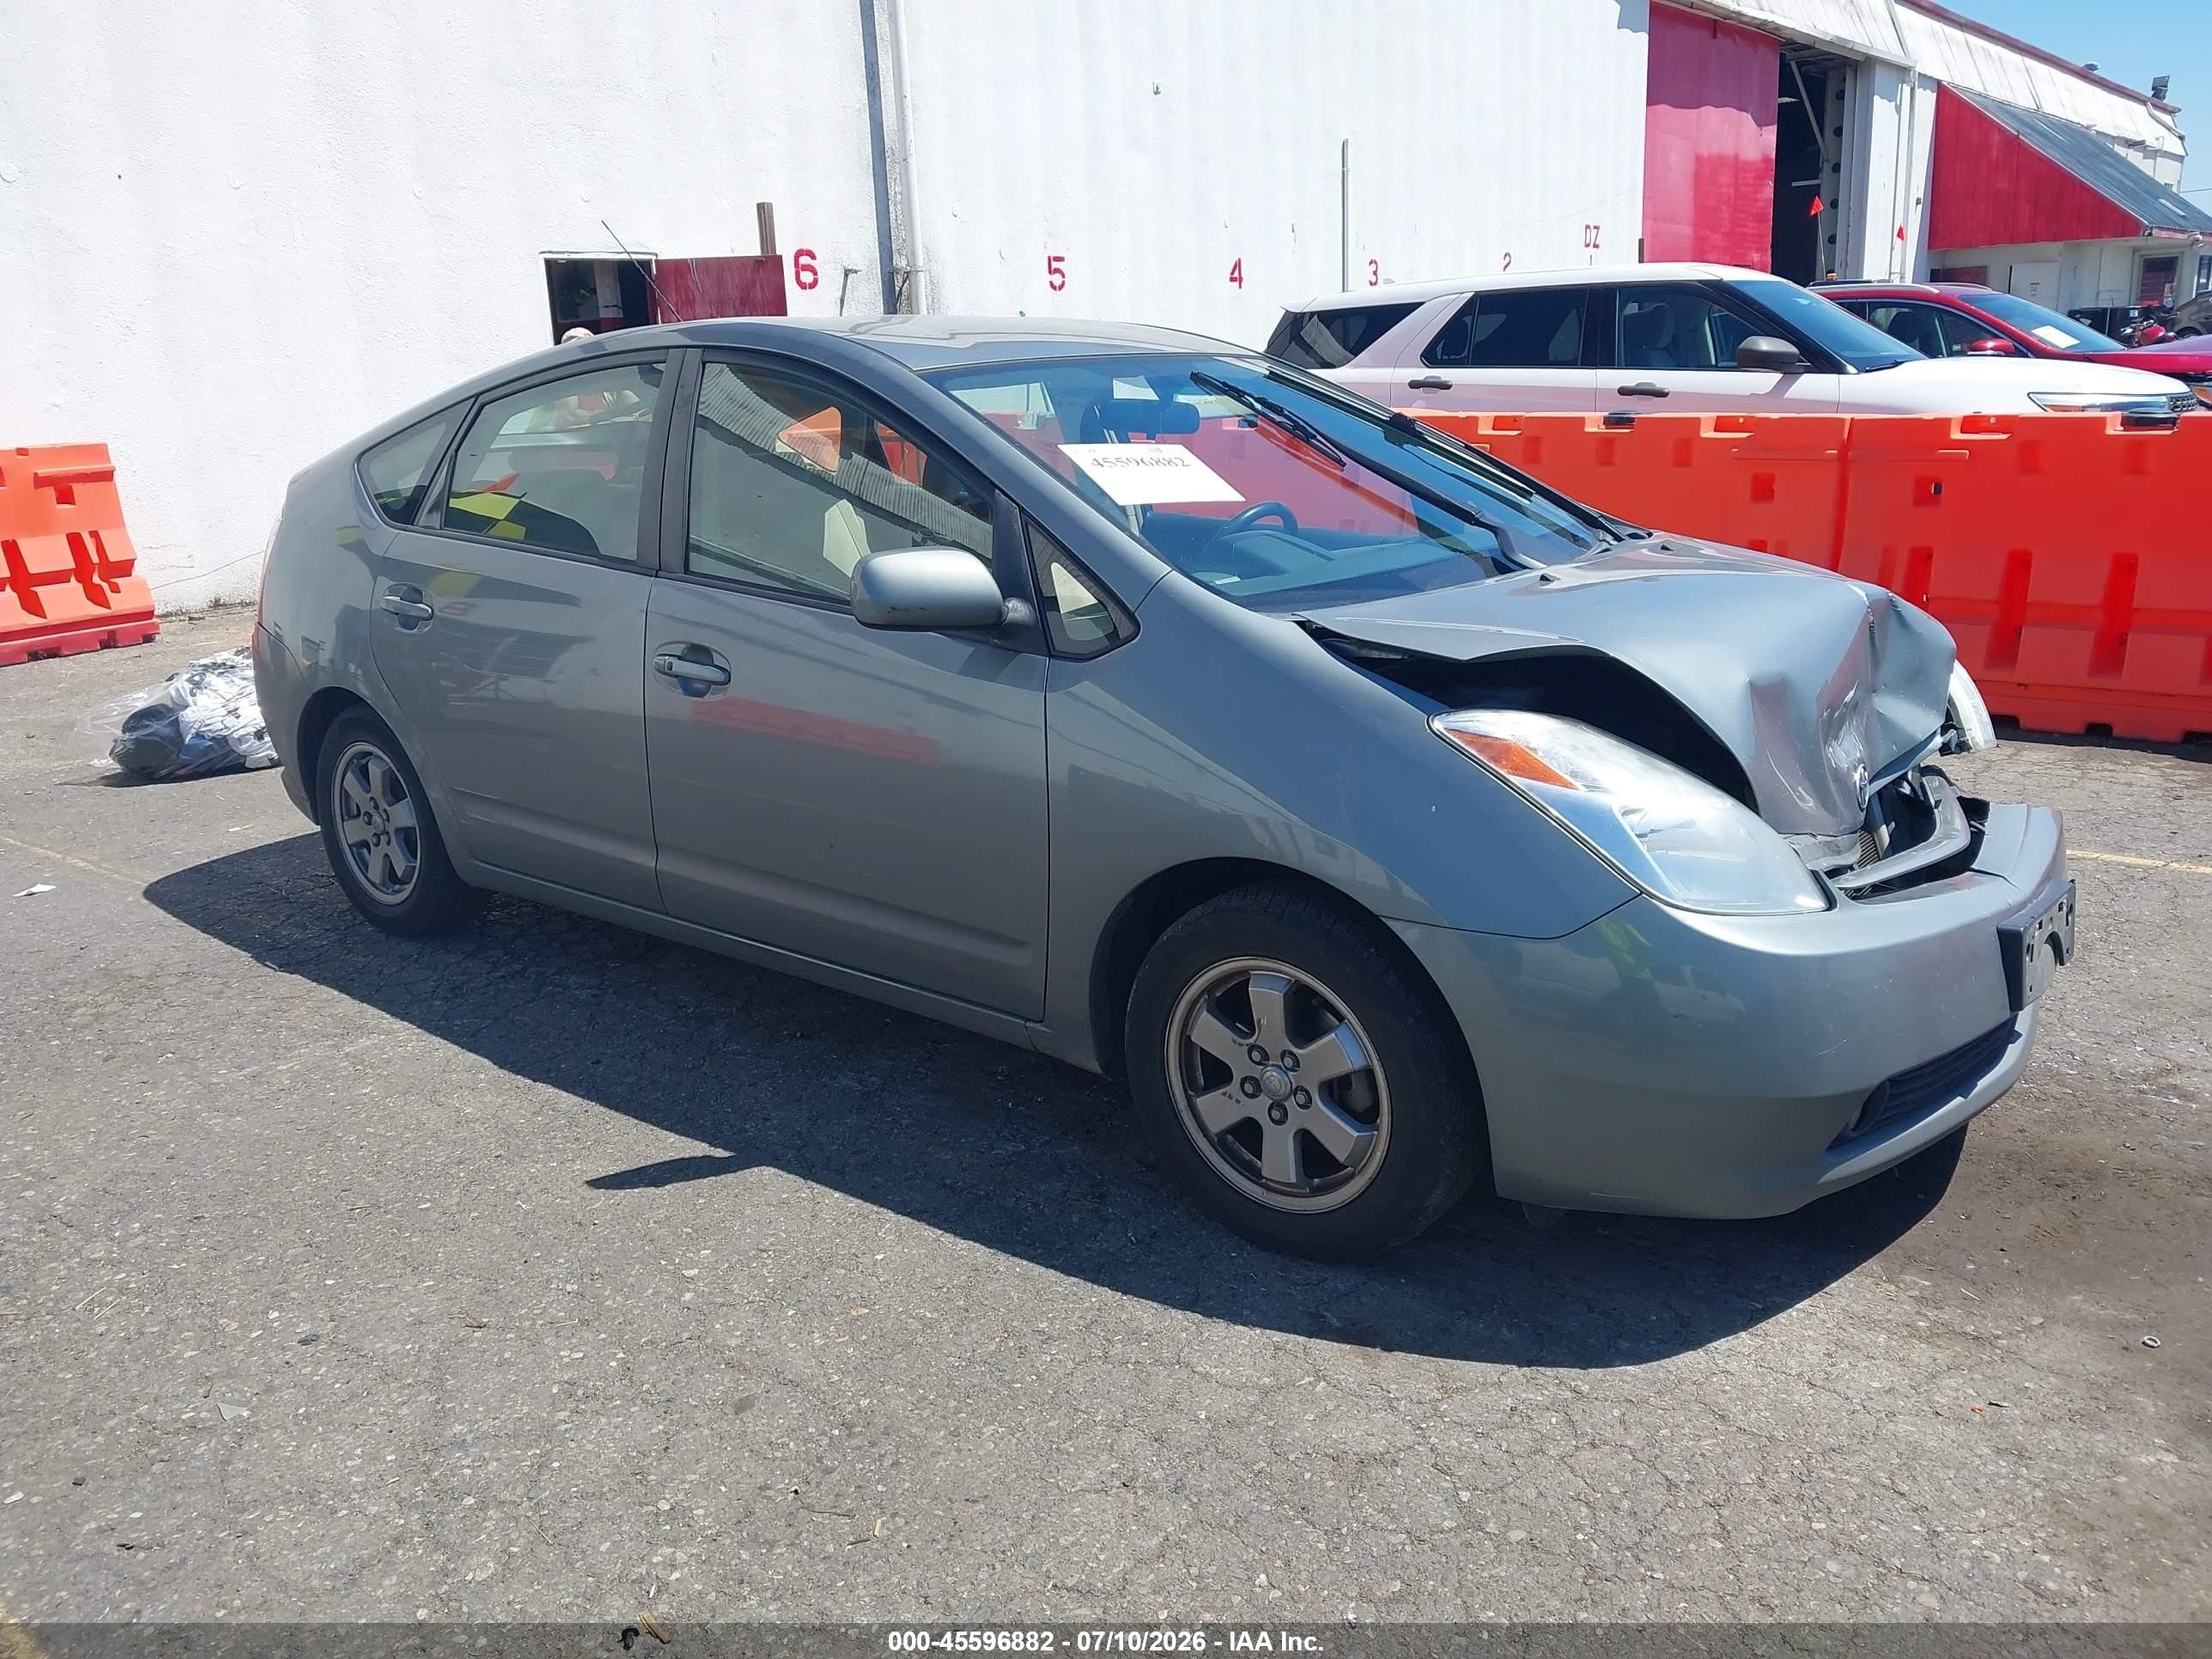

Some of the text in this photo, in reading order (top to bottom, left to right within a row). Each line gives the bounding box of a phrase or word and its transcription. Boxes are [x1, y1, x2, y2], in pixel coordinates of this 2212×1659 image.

[793, 247, 819, 291] 6
[1046, 255, 1066, 292] 5
[1229, 258, 1243, 289] 4
[1368, 258, 1379, 287] 3
